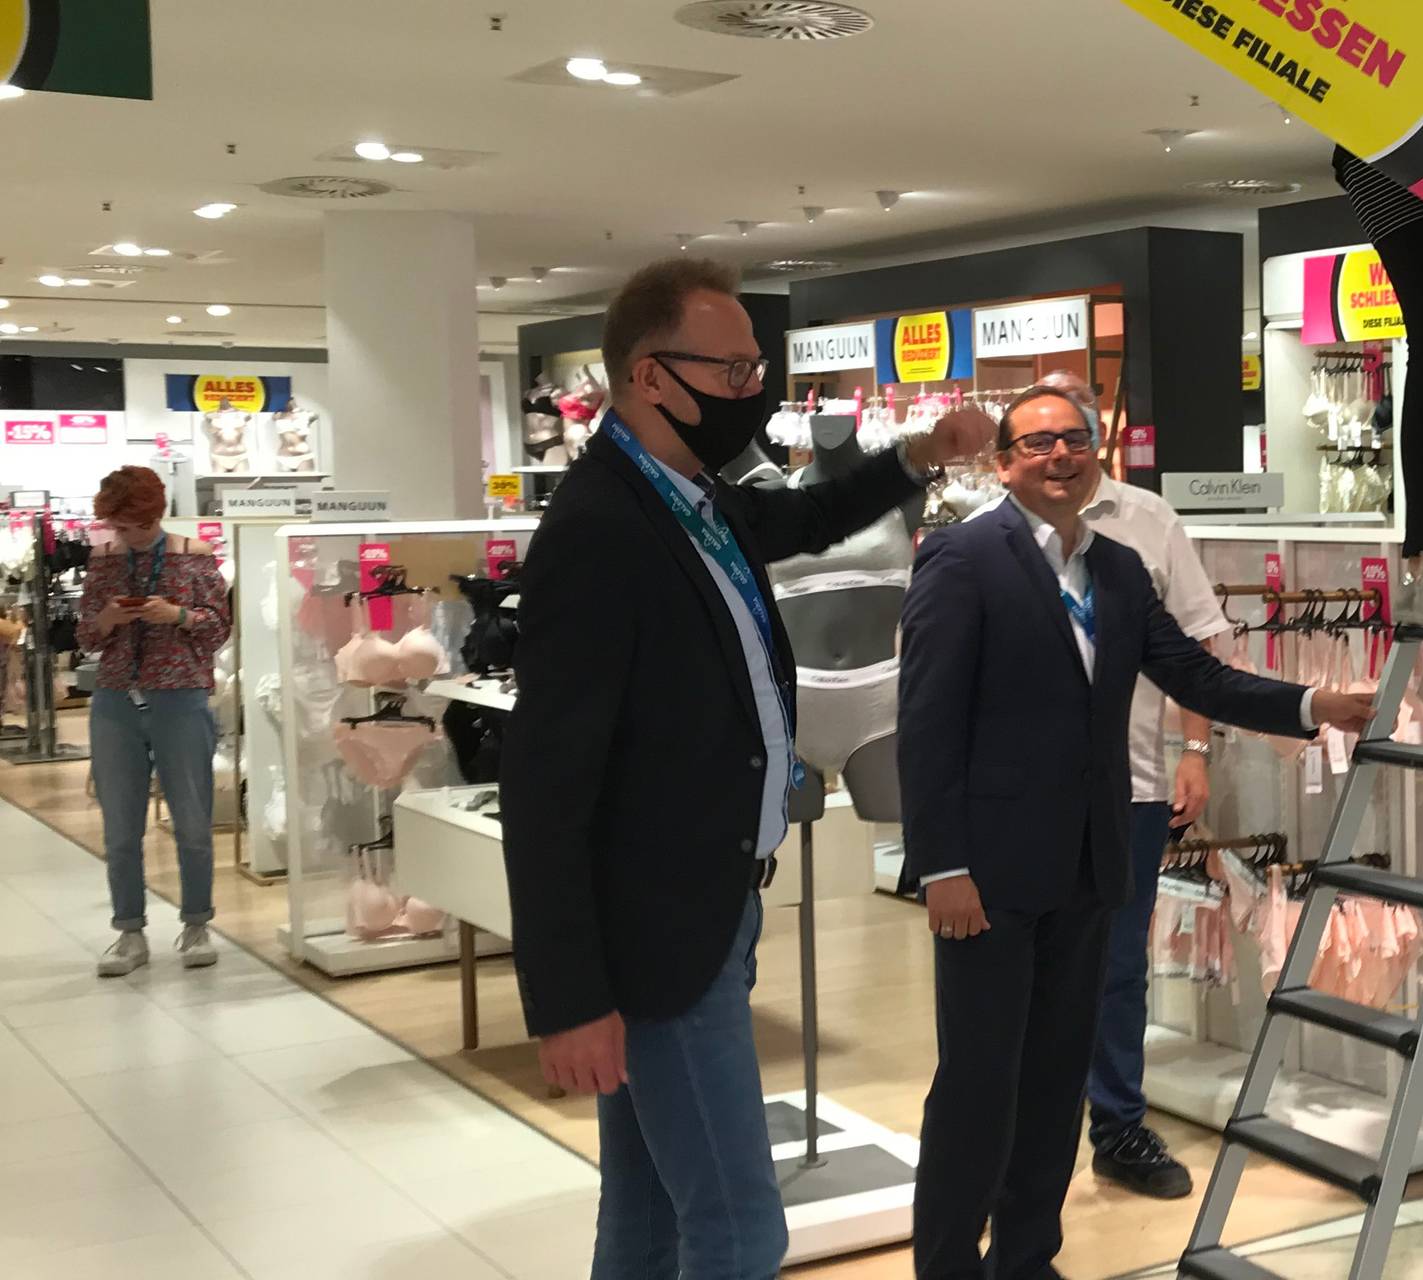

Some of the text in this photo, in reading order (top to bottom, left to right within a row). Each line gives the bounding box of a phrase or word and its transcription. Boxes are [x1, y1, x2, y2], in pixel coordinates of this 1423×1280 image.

[1161, 0, 1331, 103] ESE FILIALE
[901, 323, 942, 346] ALLES
[982, 313, 1080, 347] MANGUN
[793, 335, 869, 364] MANGUUN
[203, 380, 255, 393] ALLES
[1189, 479, 1262, 496] Calvin Klein
[228, 497, 292, 508] MANGUUN
[316, 500, 387, 512] MANGUUN
